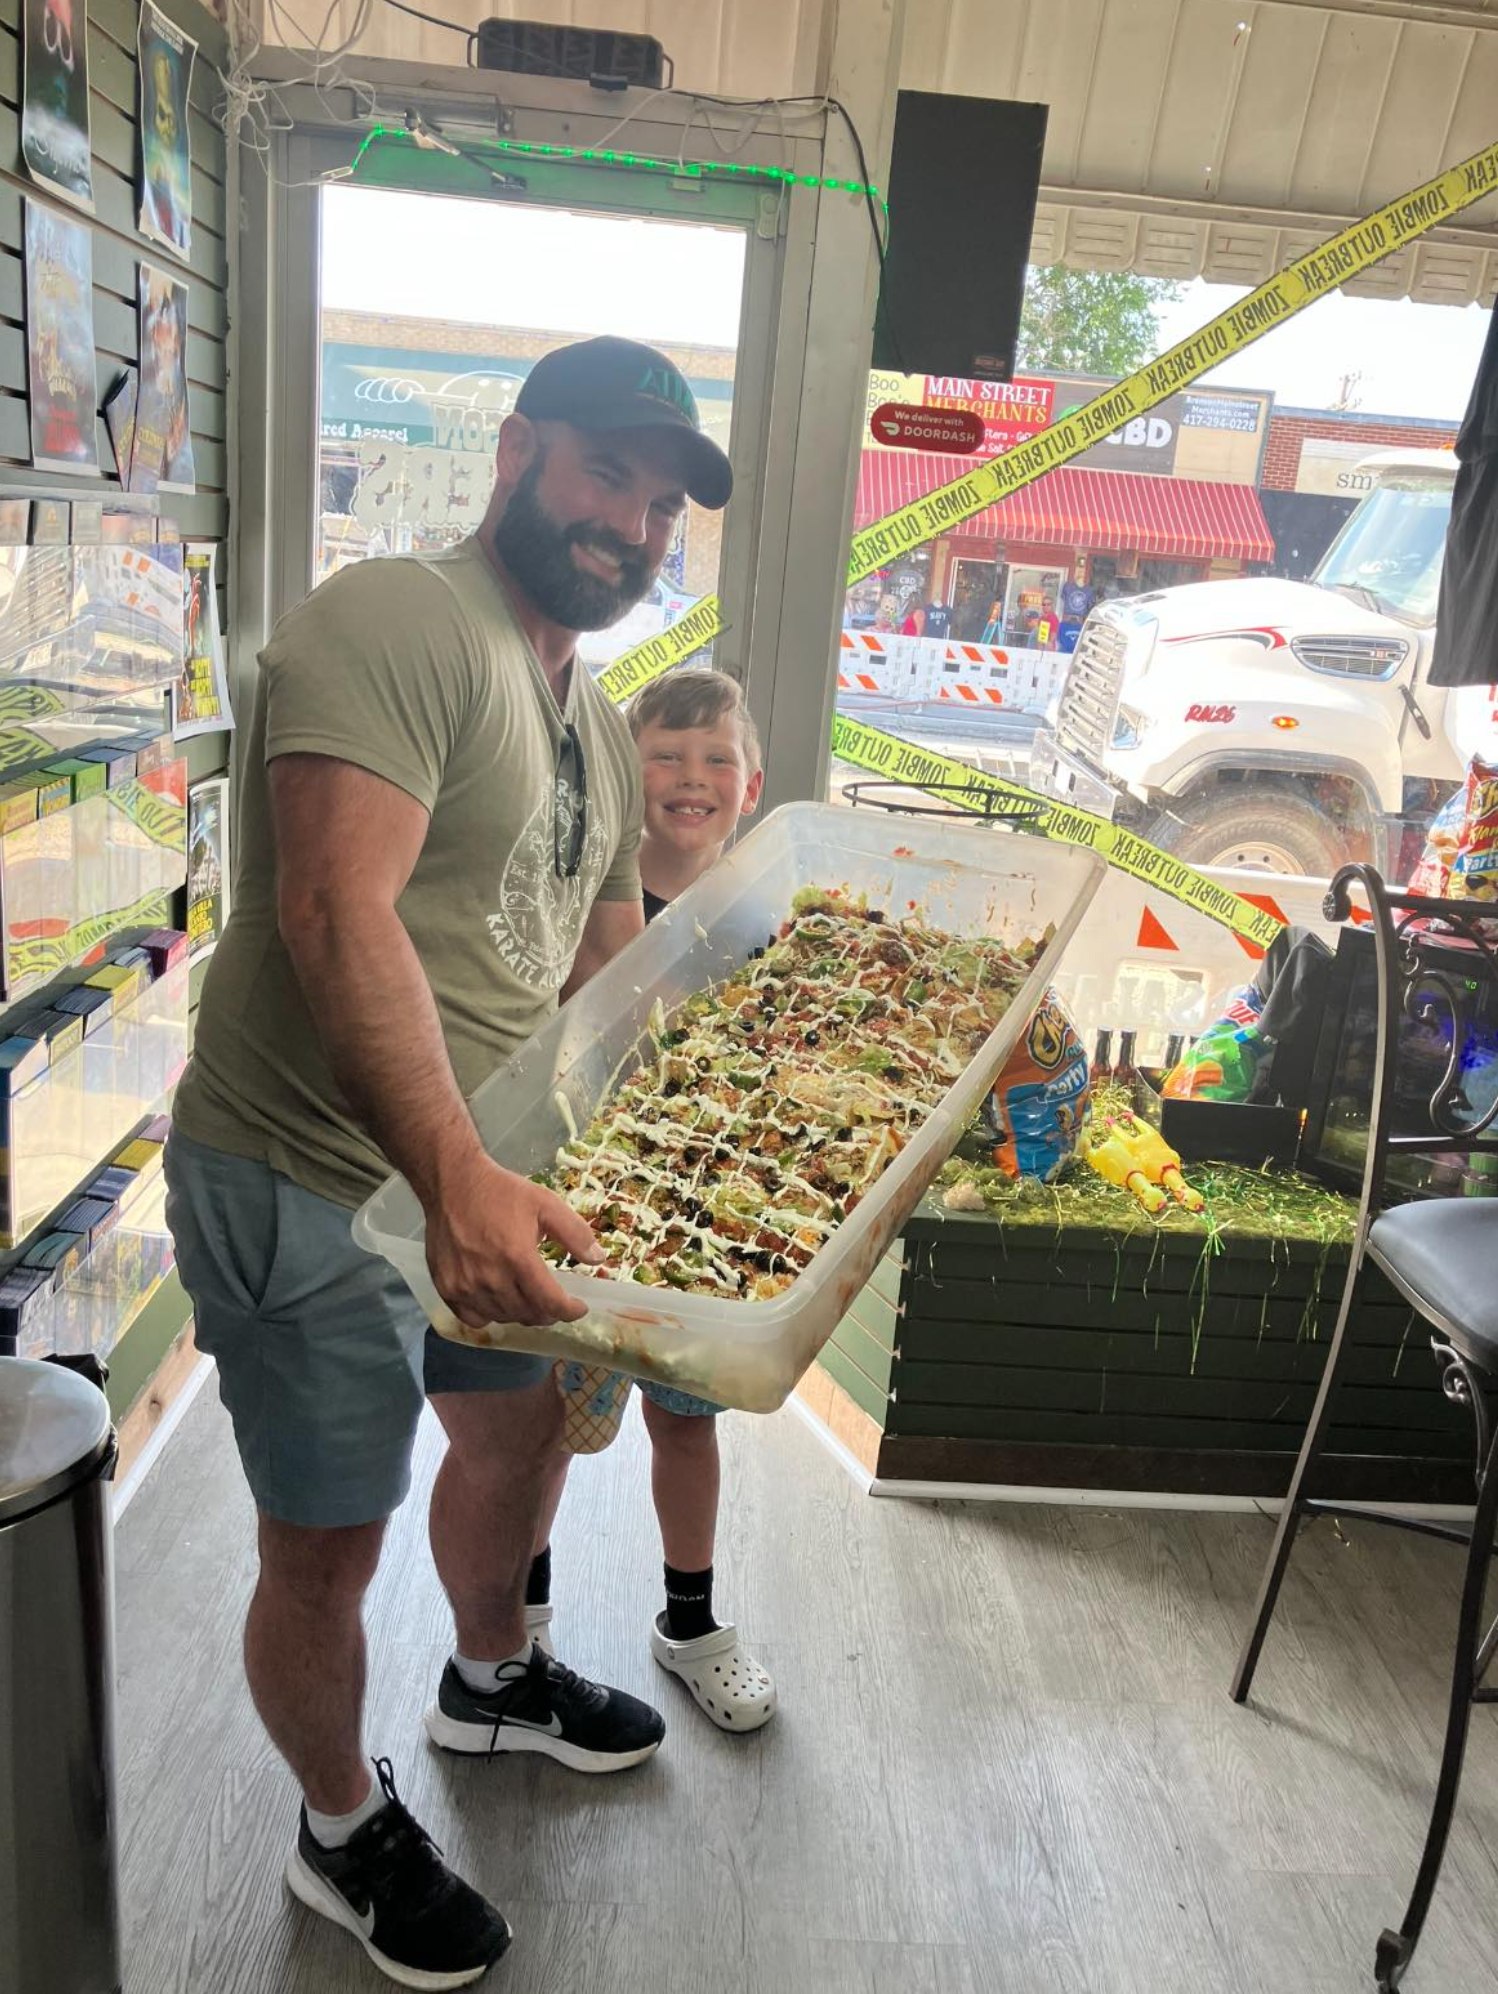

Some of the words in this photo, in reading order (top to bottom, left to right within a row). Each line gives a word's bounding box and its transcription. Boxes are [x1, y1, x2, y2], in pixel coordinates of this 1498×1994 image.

[927, 375, 974, 399] MAIN
[980, 382, 1051, 406] STREET
[894, 410, 910, 420] We
[911, 412, 943, 425] deliver
[944, 415, 964, 427] with
[903, 425, 976, 443] DOORDASH
[485, 912, 540, 985] KARATE
